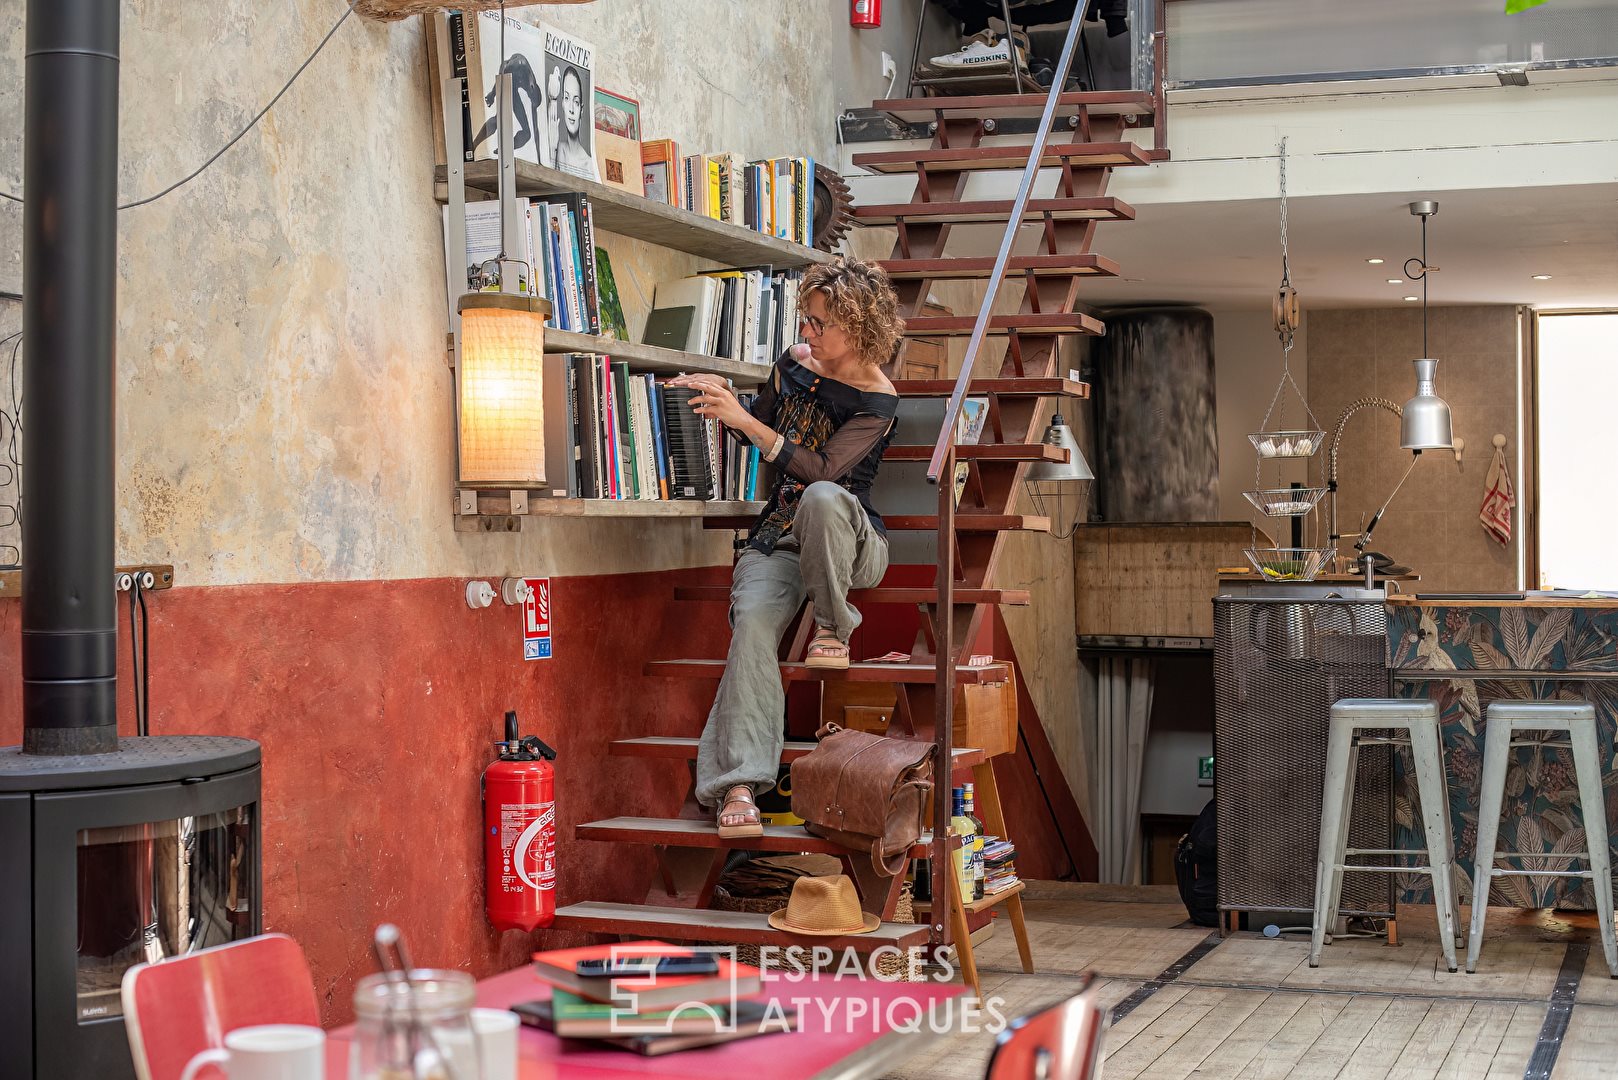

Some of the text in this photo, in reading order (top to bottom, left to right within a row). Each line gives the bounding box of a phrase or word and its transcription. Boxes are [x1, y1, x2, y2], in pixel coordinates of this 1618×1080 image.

[479, 11, 500, 21] ERB
[544, 32, 591, 68] EGOÏSTE
[962, 53, 1008, 64] REDSKINS
[582, 222, 592, 266] FRANCE
[588, 269, 593, 282] LA
